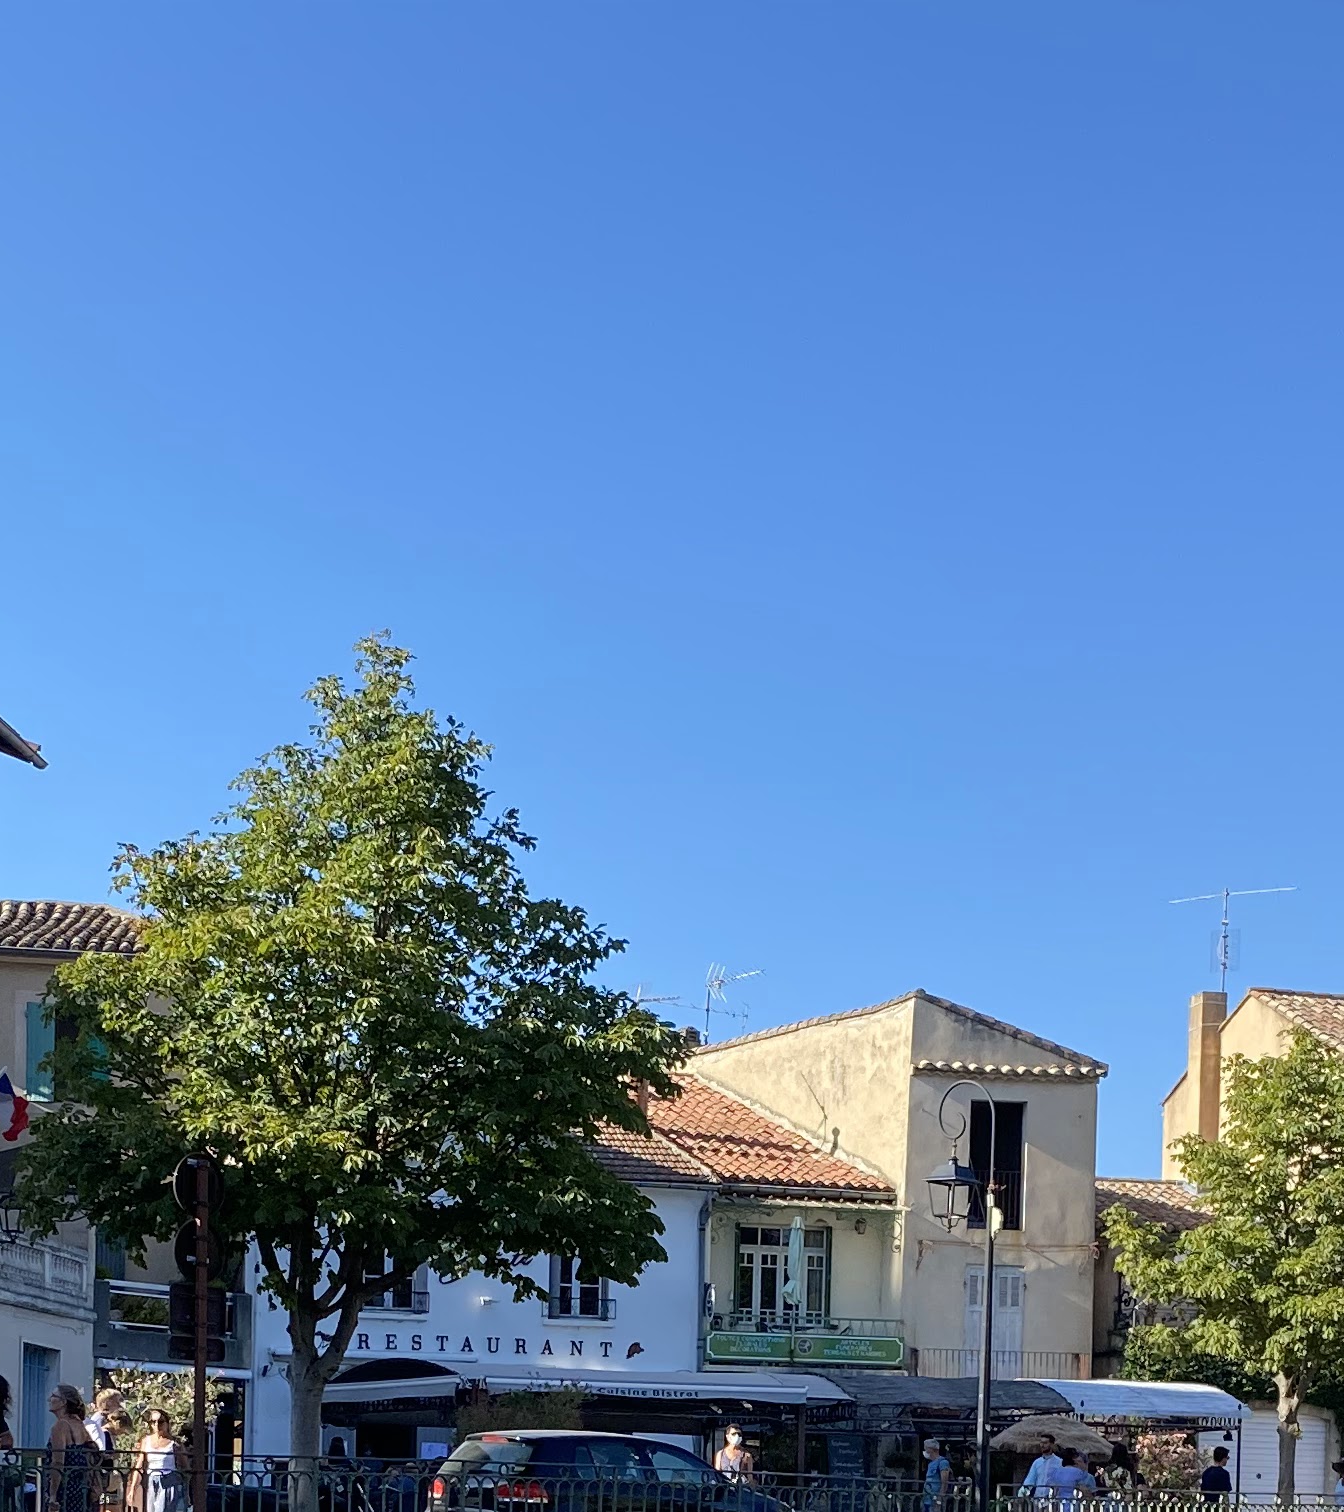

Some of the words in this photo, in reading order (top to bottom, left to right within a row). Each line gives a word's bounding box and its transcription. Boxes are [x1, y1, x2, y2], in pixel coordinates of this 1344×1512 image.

[356, 1333, 613, 1359] RESTAURANT
[596, 1386, 648, 1397] Cuisine
[652, 1388, 699, 1398] Bistrot
